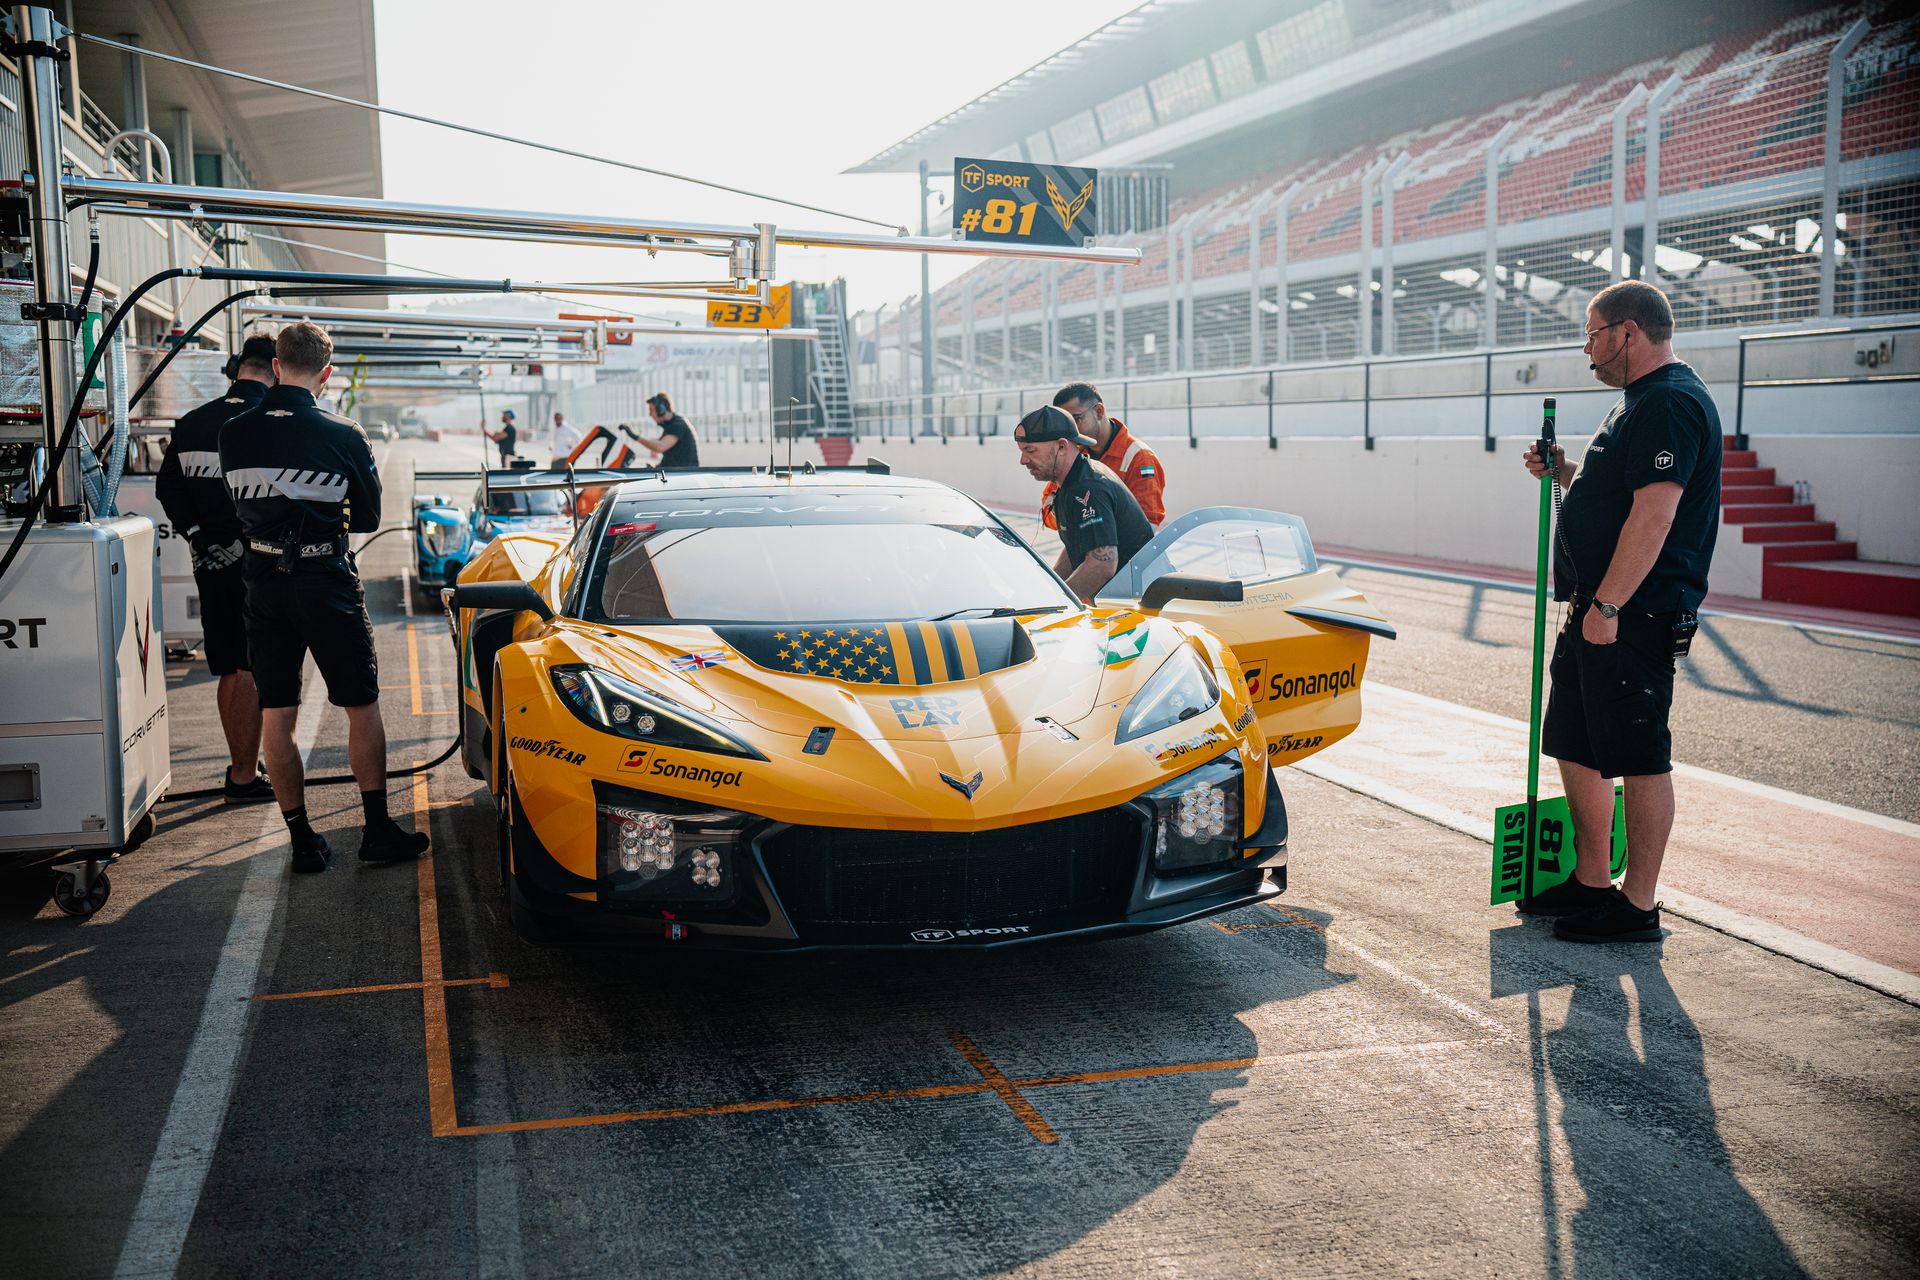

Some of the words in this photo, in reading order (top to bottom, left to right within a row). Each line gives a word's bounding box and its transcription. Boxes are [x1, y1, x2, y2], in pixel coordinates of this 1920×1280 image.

[964, 171, 982, 185] TF
[986, 173, 1030, 188] SPORT
[960, 198, 1038, 236] #81
[711, 304, 763, 323] #33
[1657, 456, 1671, 466] TF
[634, 505, 896, 519] CORVET
[1269, 662, 1356, 700] Sonangol
[888, 696, 958, 713] REP
[122, 704, 166, 754] CORVETTE
[897, 710, 961, 729] LAY
[1166, 727, 1222, 758] Sonangol
[650, 758, 743, 788] Sonangol
[1501, 811, 1526, 895] START
[1537, 818, 1563, 874] 81
[916, 931, 945, 939] TF
[956, 926, 1030, 937] SPORT
